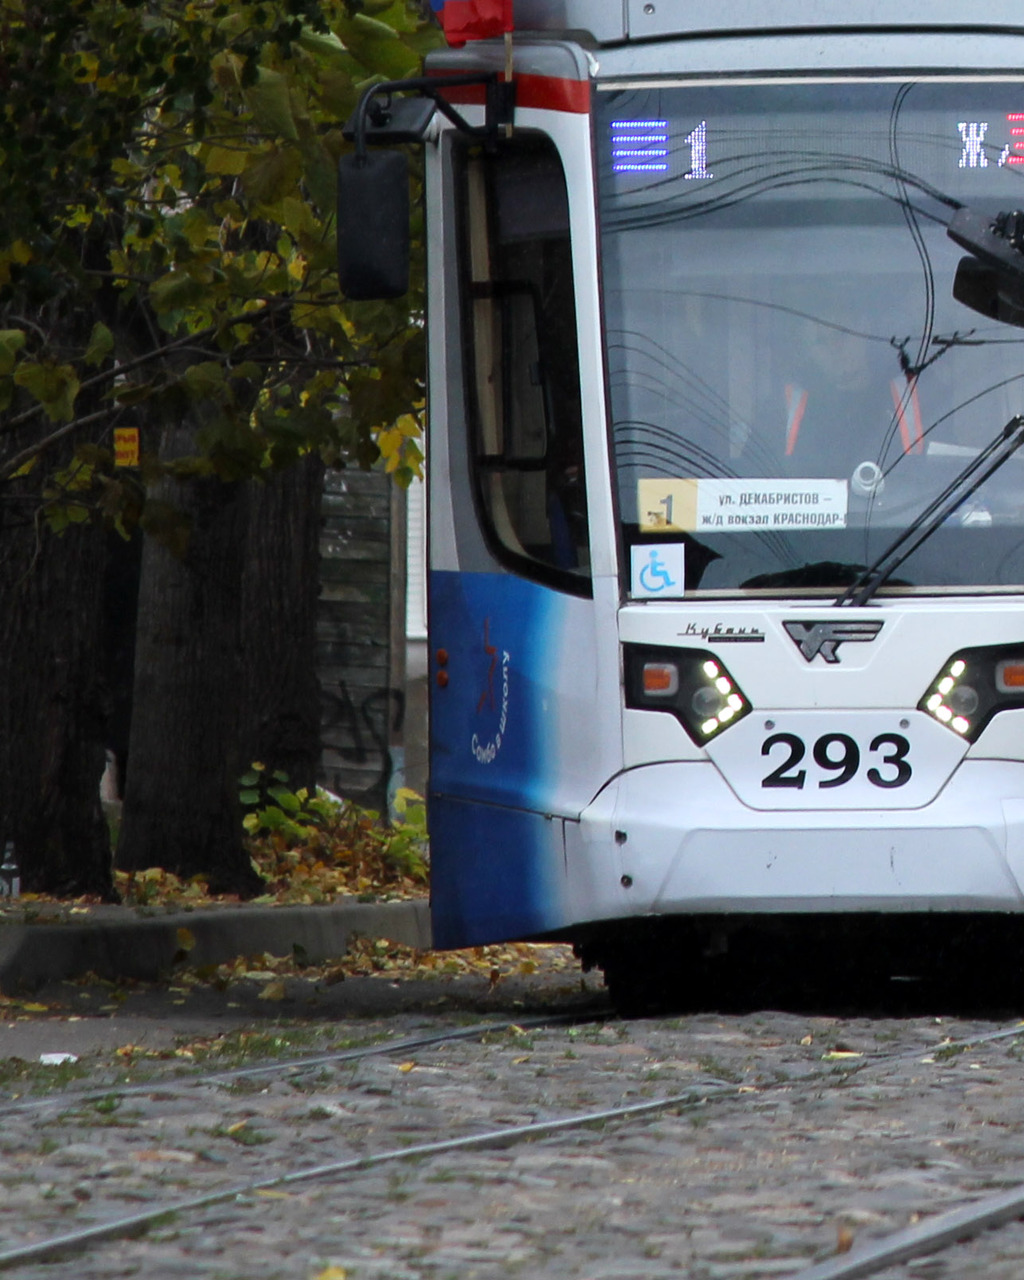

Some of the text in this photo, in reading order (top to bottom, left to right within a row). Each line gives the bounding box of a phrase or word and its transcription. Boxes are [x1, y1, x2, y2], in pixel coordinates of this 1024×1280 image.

[684, 120, 714, 180] 1
[659, 494, 673, 526] 1
[718, 494, 736, 506] ул.
[739, 492, 820, 507] ДЕКАБРИСТОВ
[702, 513, 724, 527] ж/д
[727, 513, 769, 526] вокзал
[684, 622, 760, 640] Кубань
[761, 732, 913, 790] 293
